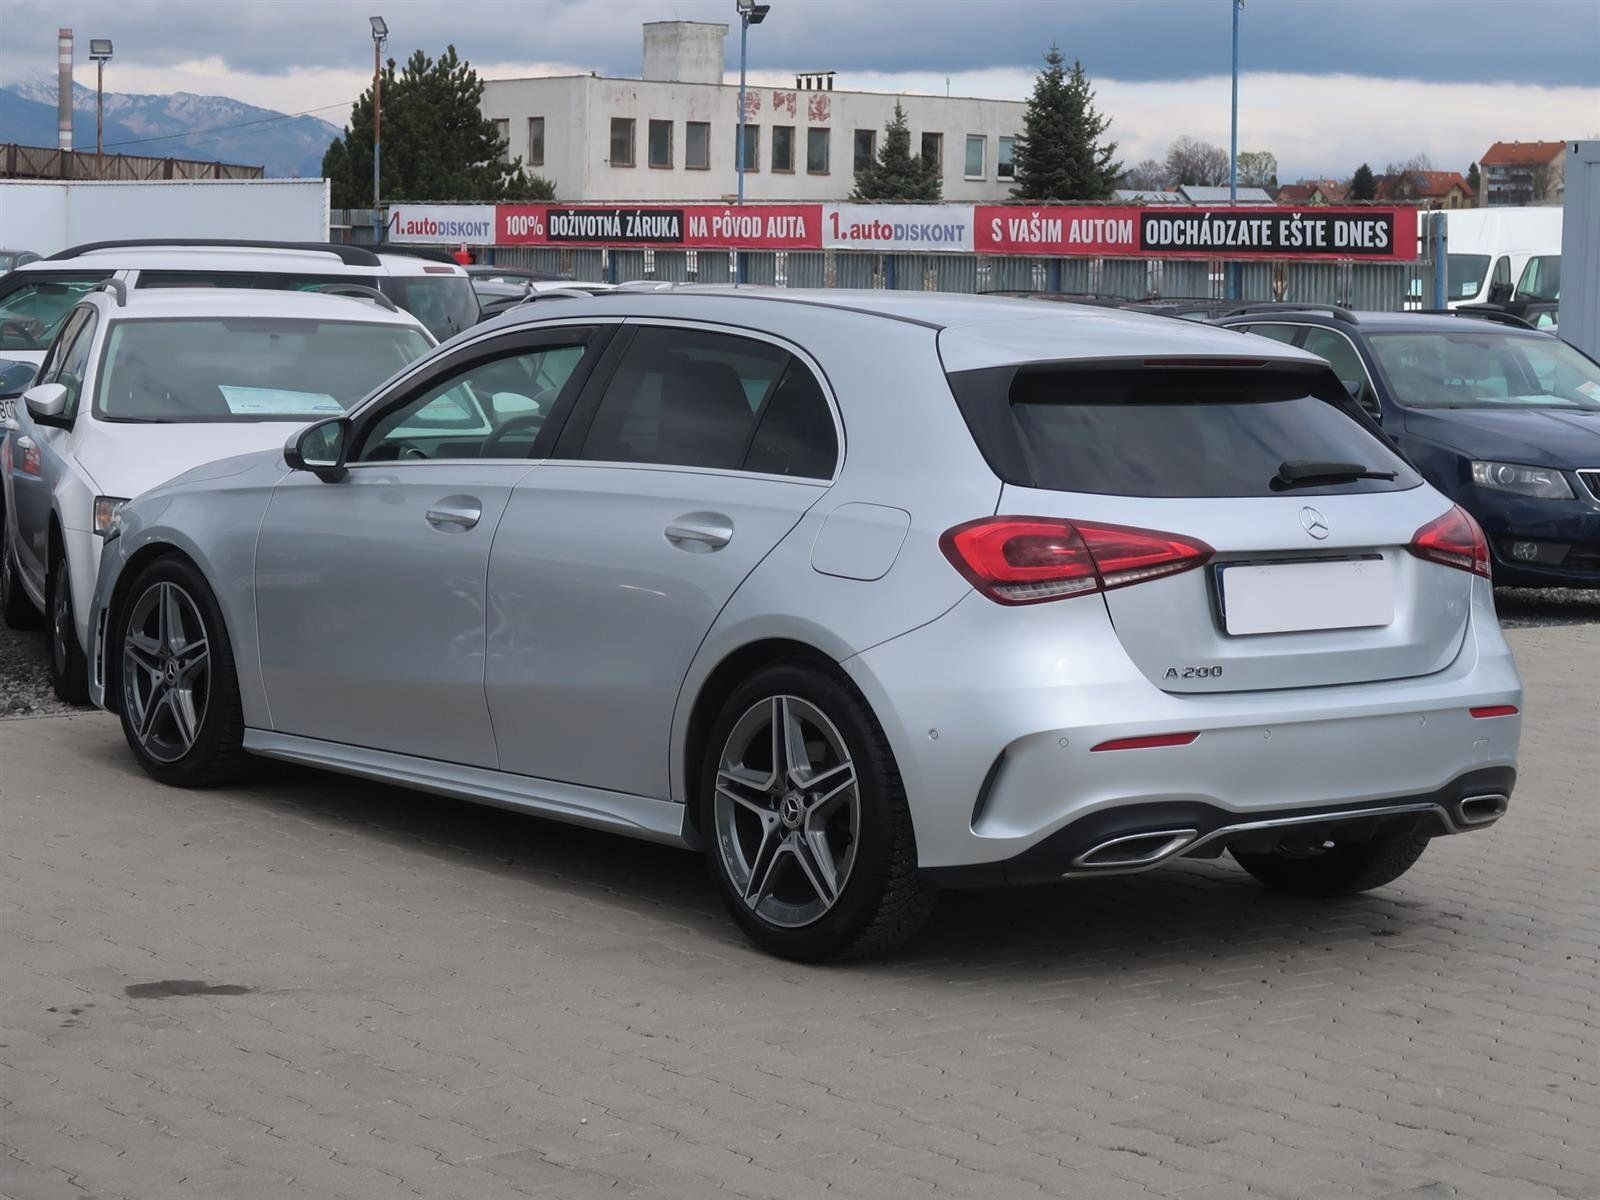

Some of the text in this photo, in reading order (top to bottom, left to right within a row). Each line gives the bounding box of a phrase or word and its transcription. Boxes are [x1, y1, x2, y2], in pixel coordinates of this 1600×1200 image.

[506, 210, 806, 239] 100% DOŽIVOTNÁ ZÁRUKA NA PÔVOD AUTA
[991, 212, 1389, 248] S VAŠIM AUTOM ODCHÁDZATE EŠTE DNES
[1164, 665, 1223, 678] A 200
